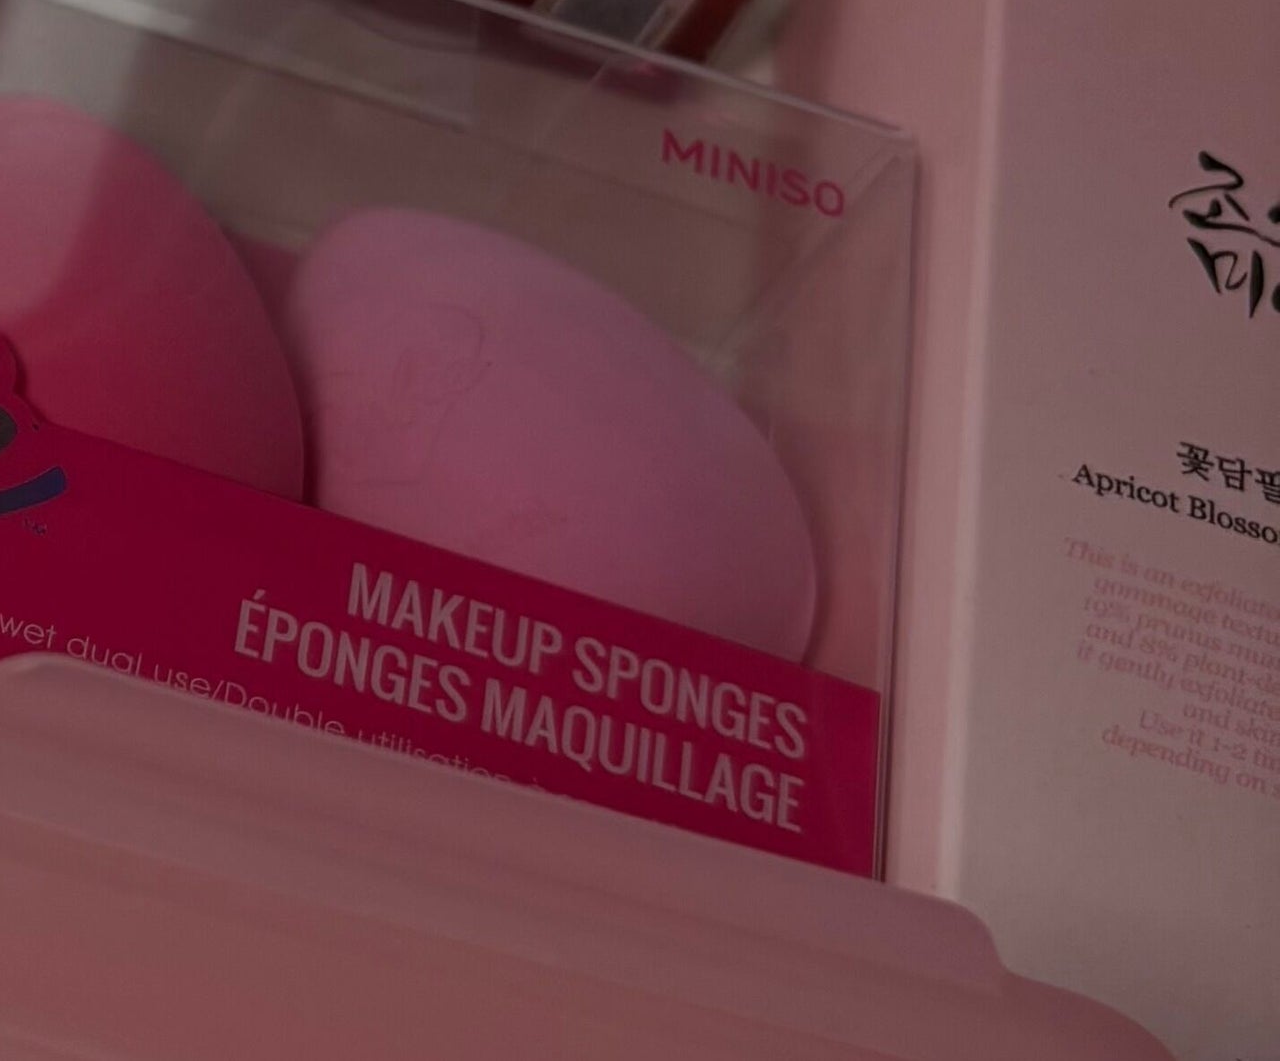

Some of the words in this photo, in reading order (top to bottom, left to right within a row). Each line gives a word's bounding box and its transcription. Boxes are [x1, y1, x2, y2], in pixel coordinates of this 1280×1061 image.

[661, 128, 845, 218] MINISO
[1073, 463, 1180, 514] Apricot
[65, 634, 143, 676] dual
[346, 560, 563, 676] MAKEUP
[571, 634, 809, 760] SPONGES
[232, 588, 473, 725] ÉPONGES
[479, 677, 806, 836] MAQUILLAGE
